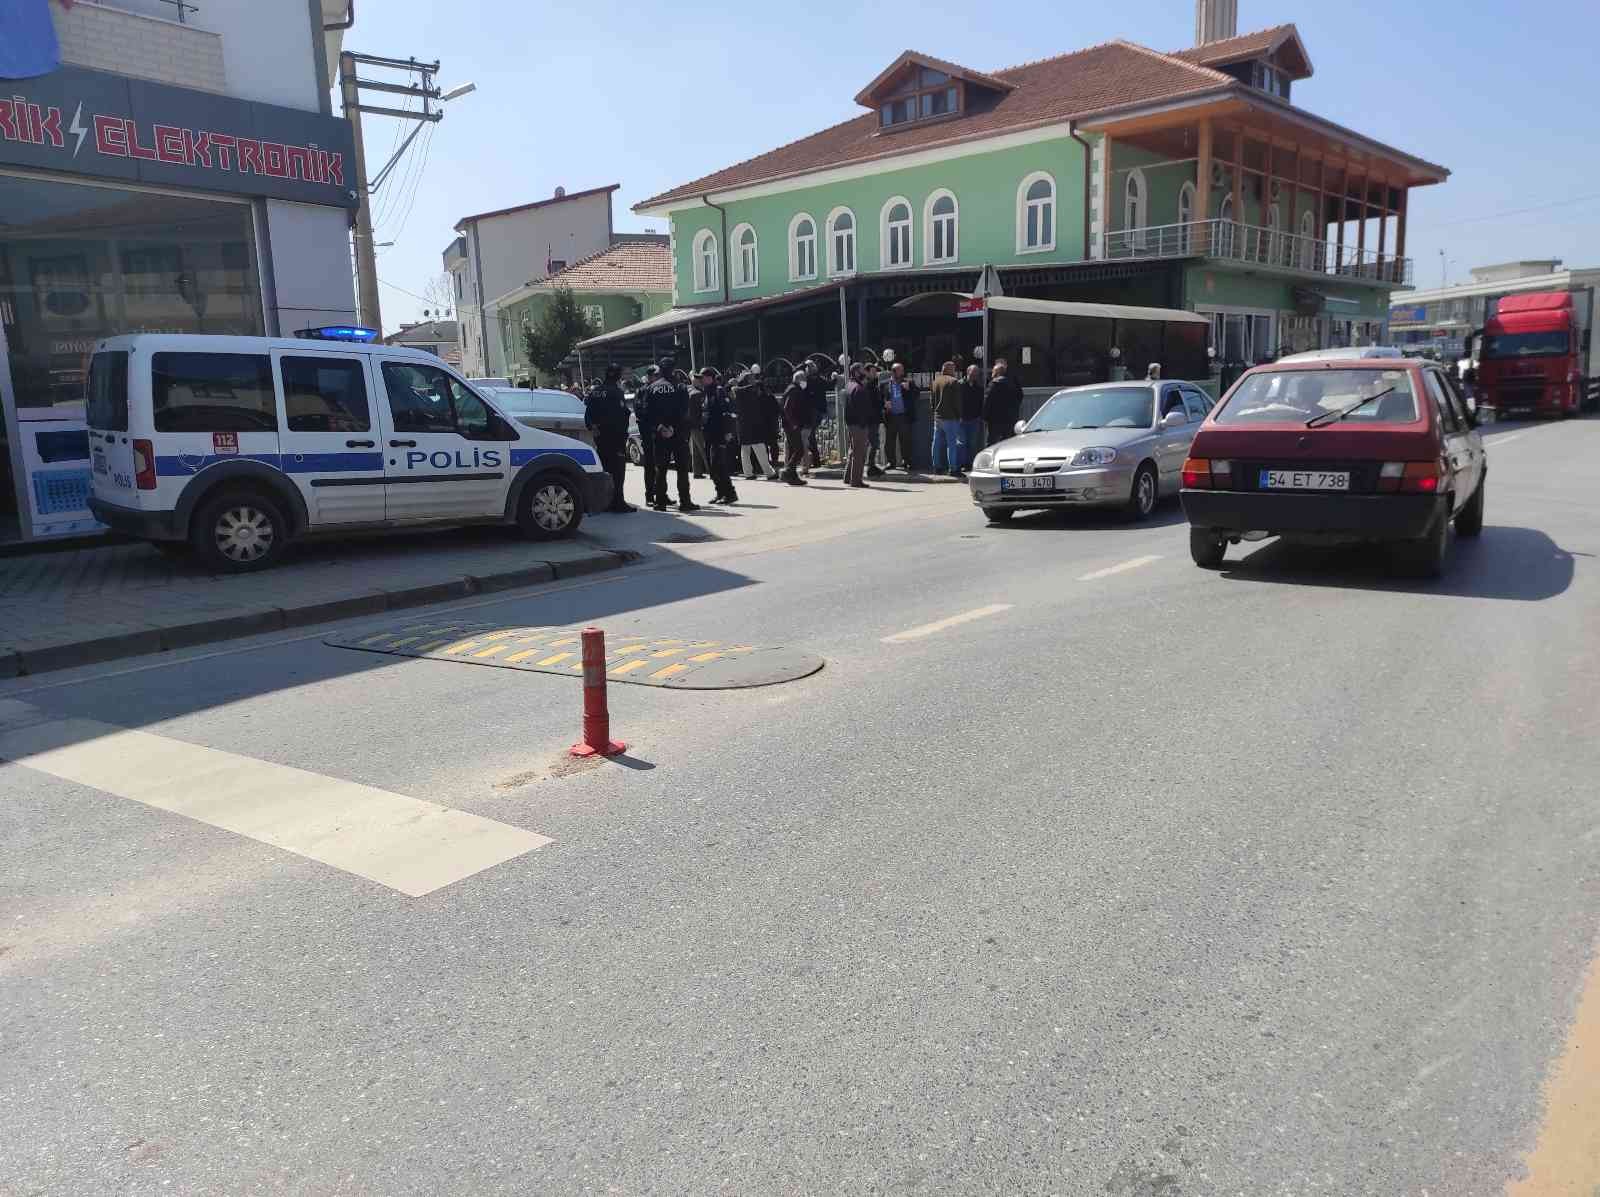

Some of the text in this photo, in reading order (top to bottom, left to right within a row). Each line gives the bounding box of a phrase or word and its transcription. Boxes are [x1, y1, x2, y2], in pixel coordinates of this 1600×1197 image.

[94, 114, 344, 187] ELEKTRONİK
[215, 433, 235, 446] 112
[407, 446, 502, 469] POLİS
[1269, 472, 1345, 488] 54 ET 738
